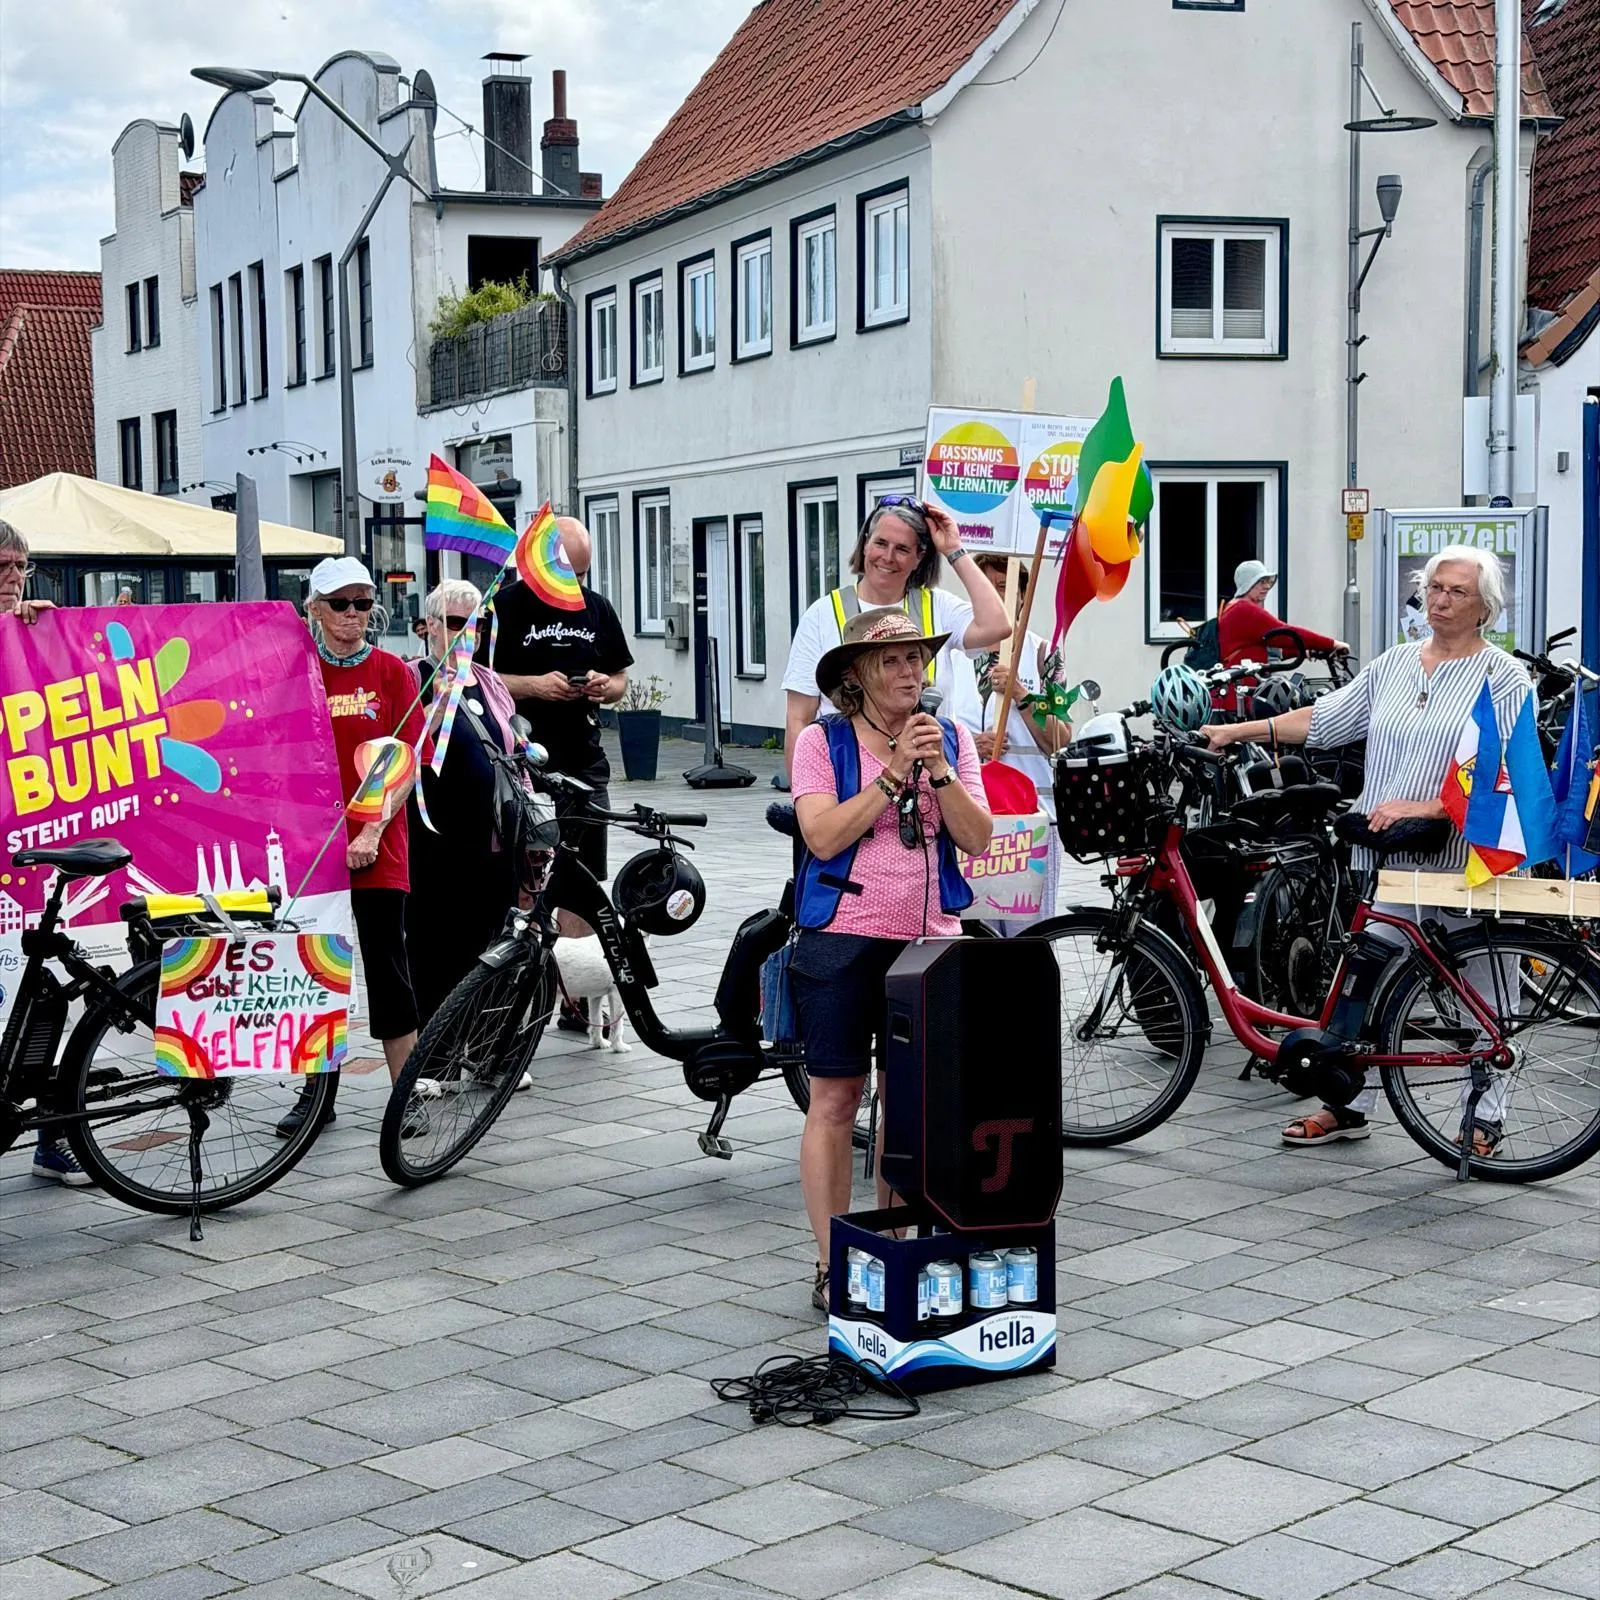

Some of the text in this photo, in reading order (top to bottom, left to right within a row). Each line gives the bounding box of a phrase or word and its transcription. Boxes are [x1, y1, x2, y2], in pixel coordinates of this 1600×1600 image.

[939, 445, 1004, 462] RASSISMUS
[942, 461, 994, 478] IST KEINE
[939, 476, 1010, 494] ALTERNATIVE
[1049, 476, 1065, 489] DIE
[1398, 522, 1516, 553] TanzZeit
[523, 622, 595, 646] Antifascist
[0, 657, 160, 753] PELN
[331, 703, 367, 717] BUNT
[7, 717, 168, 816] BUNT
[7, 794, 140, 854] STEHT AUF!
[971, 852, 1031, 877] BUNT
[225, 940, 276, 972] ES
[186, 972, 244, 1002] Gibt
[213, 991, 330, 1014] ALTERNATIVE
[235, 1013, 277, 1029] NUR
[858, 1327, 887, 1359] hella
[979, 1320, 1034, 1352] hella
